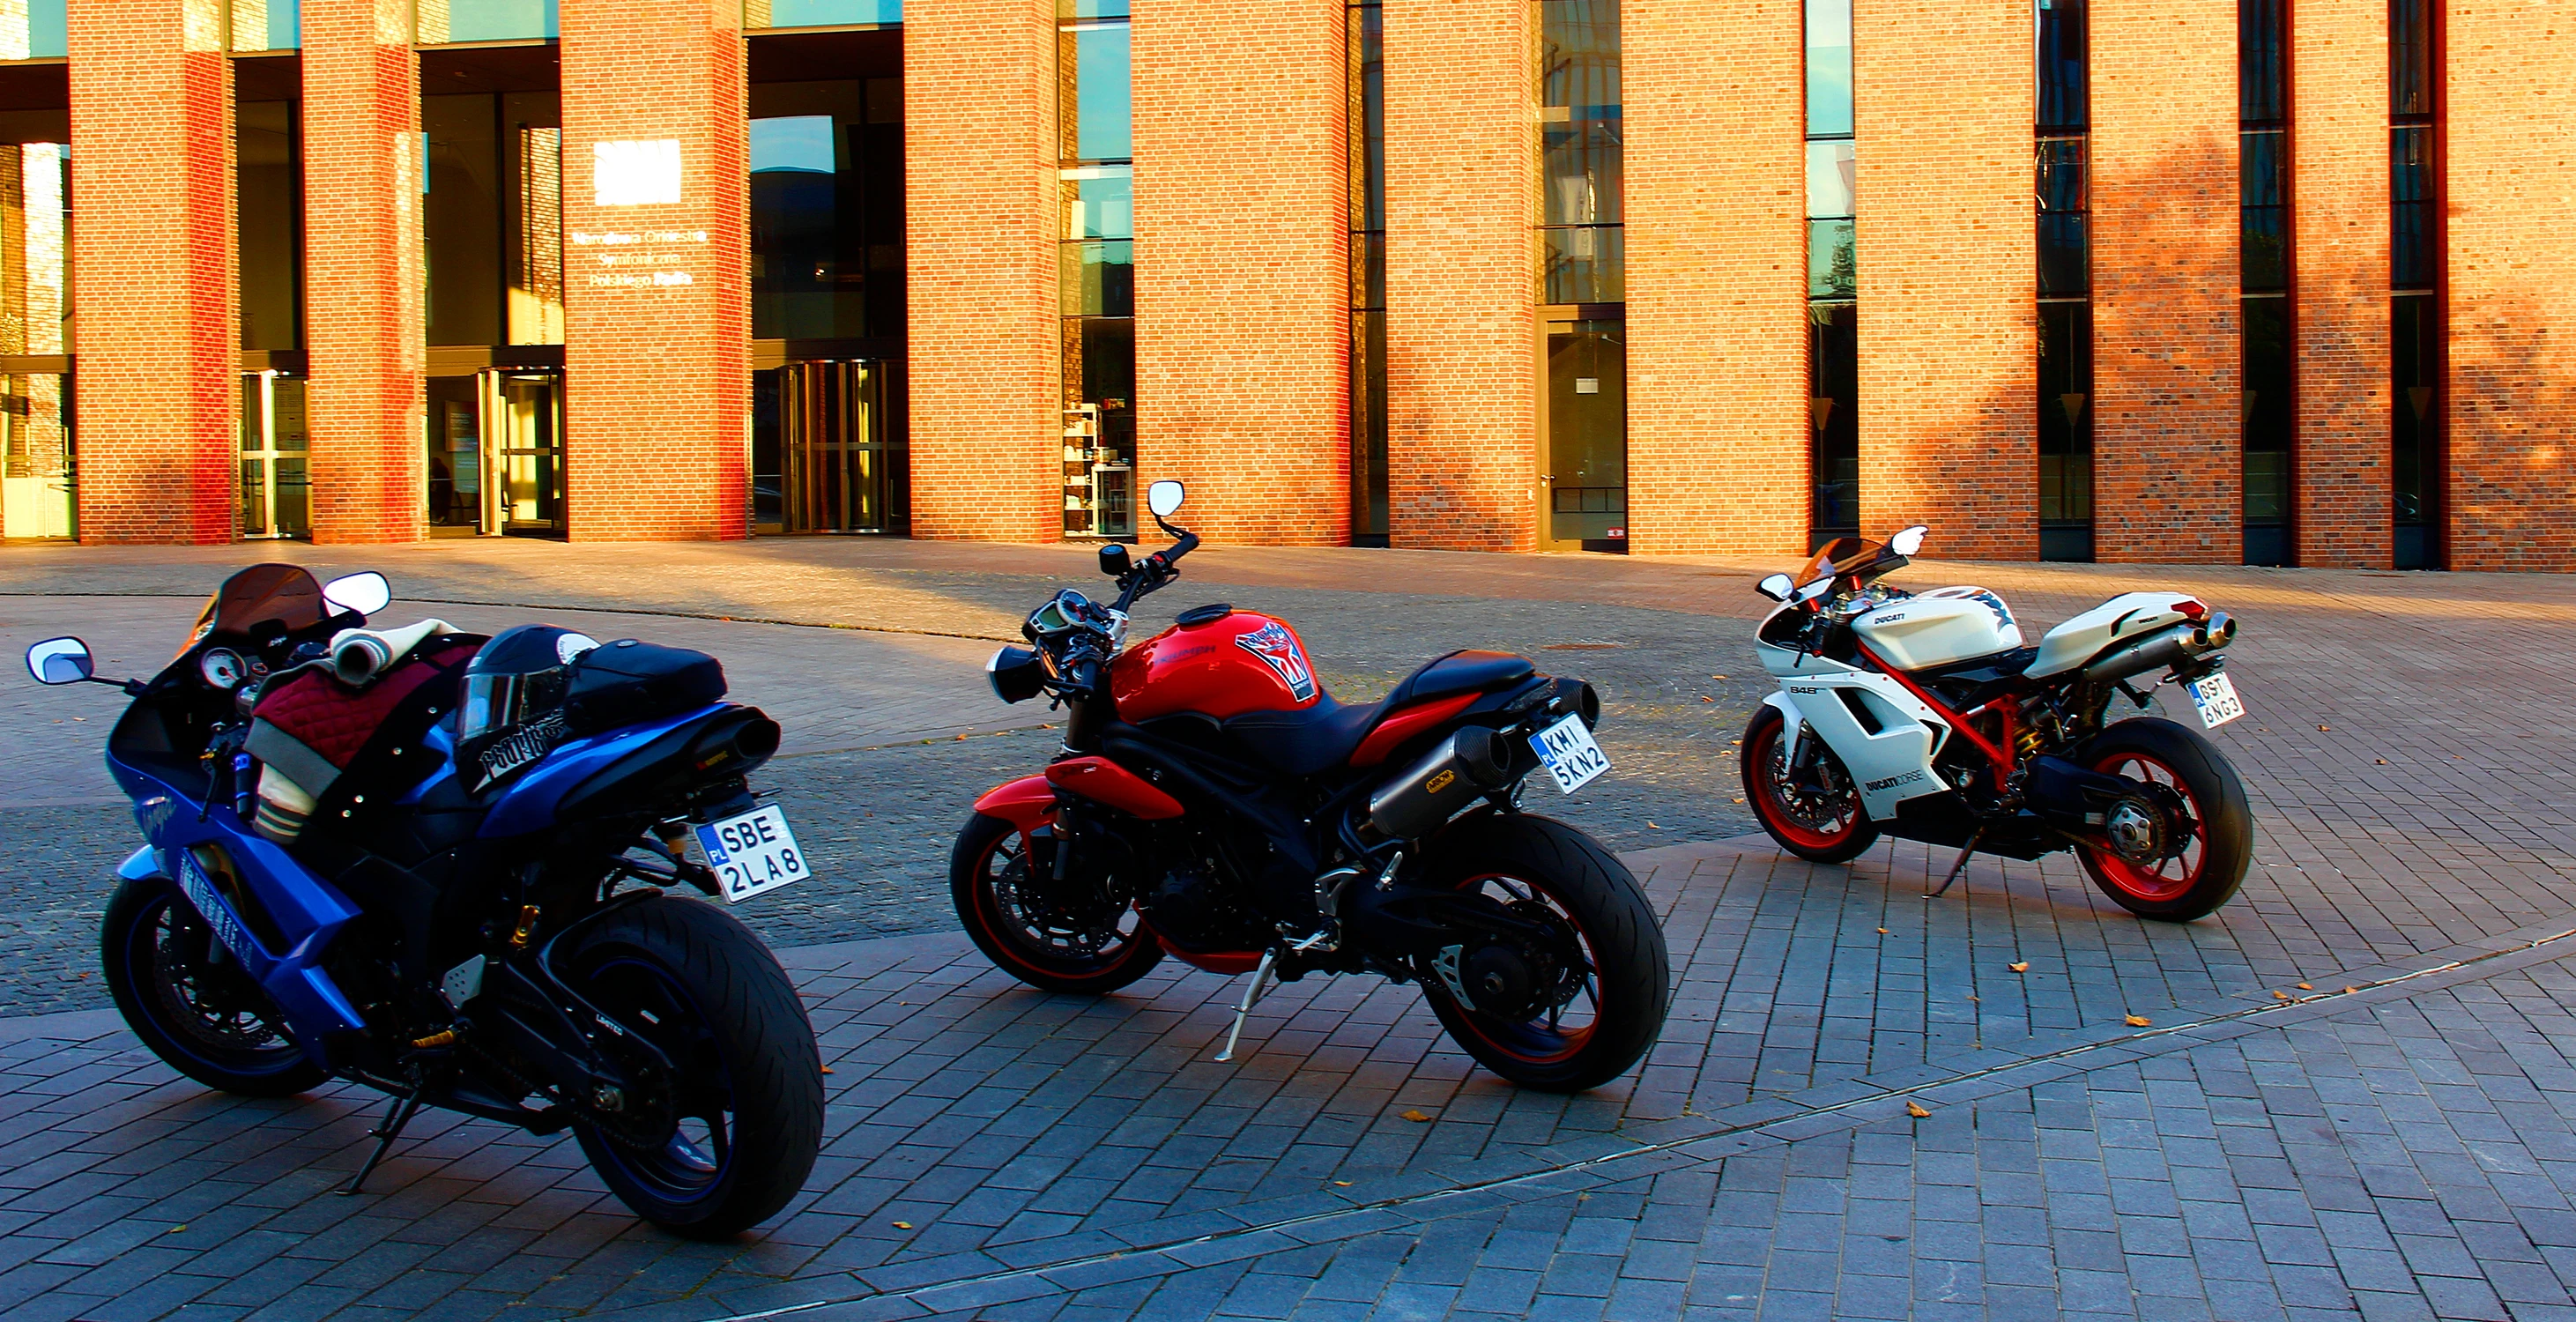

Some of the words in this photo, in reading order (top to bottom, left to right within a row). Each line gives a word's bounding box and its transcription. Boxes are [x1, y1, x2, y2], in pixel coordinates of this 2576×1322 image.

[598, 251, 681, 268] Symfoniczna
[589, 273, 652, 289] Polskiego
[1874, 613, 1905, 624] DUCATI
[1154, 644, 1216, 665] TRIUMPH
[1790, 686, 1817, 694] 848
[2199, 678, 2224, 700] GST
[2206, 697, 2238, 723] 6NG3
[1544, 724, 1580, 757] KMI
[1541, 753, 1555, 765] PL
[1554, 746, 1605, 786] 5KN2
[721, 814, 777, 853] SBE
[709, 848, 727, 863] PL
[724, 848, 800, 894] 2LA8
